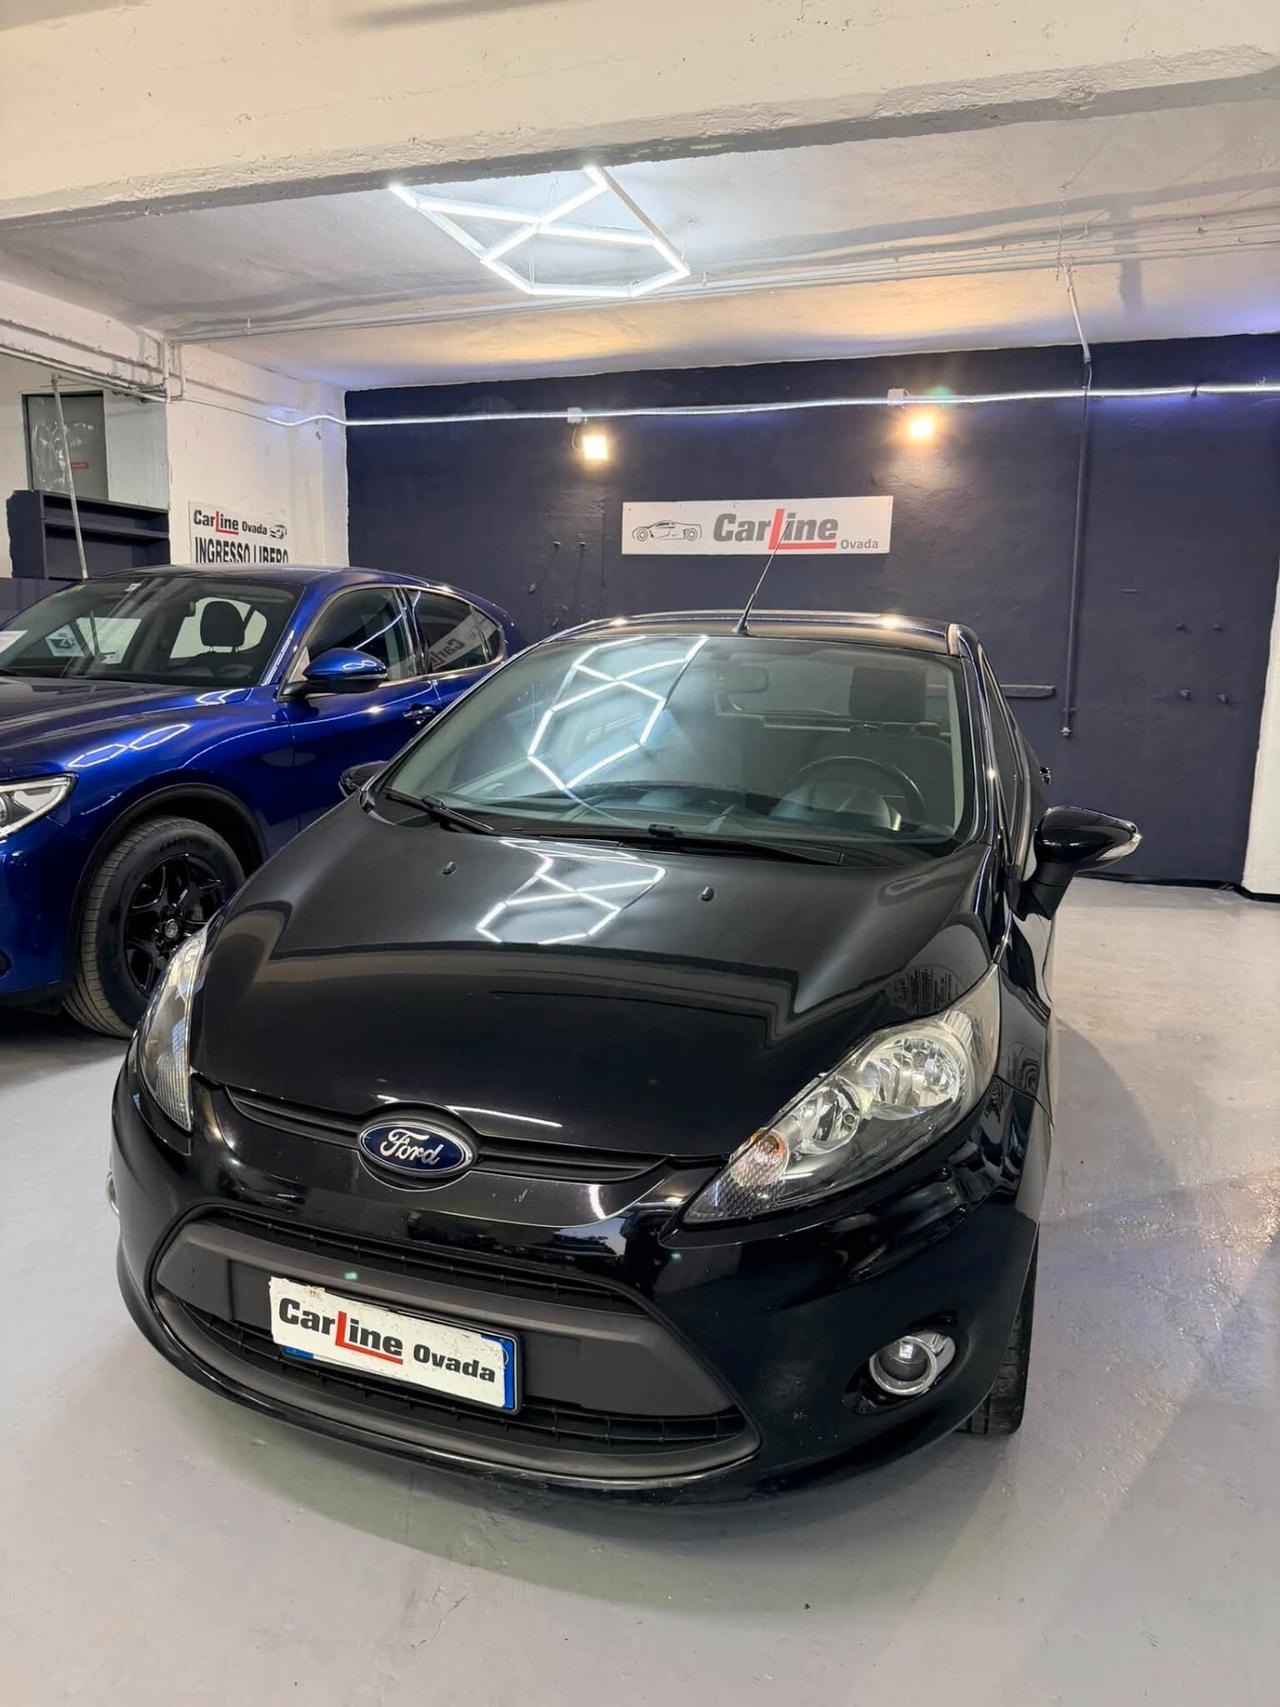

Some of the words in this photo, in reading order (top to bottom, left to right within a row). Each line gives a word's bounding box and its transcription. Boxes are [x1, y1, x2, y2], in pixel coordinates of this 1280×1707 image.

[193, 510, 239, 535] CarLine
[242, 520, 267, 535] Ovada
[713, 508, 838, 550] CarLine
[841, 539, 879, 550] Ovada
[195, 536, 250, 563] INGRESSO
[380, 1128, 444, 1165] Ford
[279, 1298, 404, 1365] CarLine
[413, 1343, 496, 1383] Ovada
